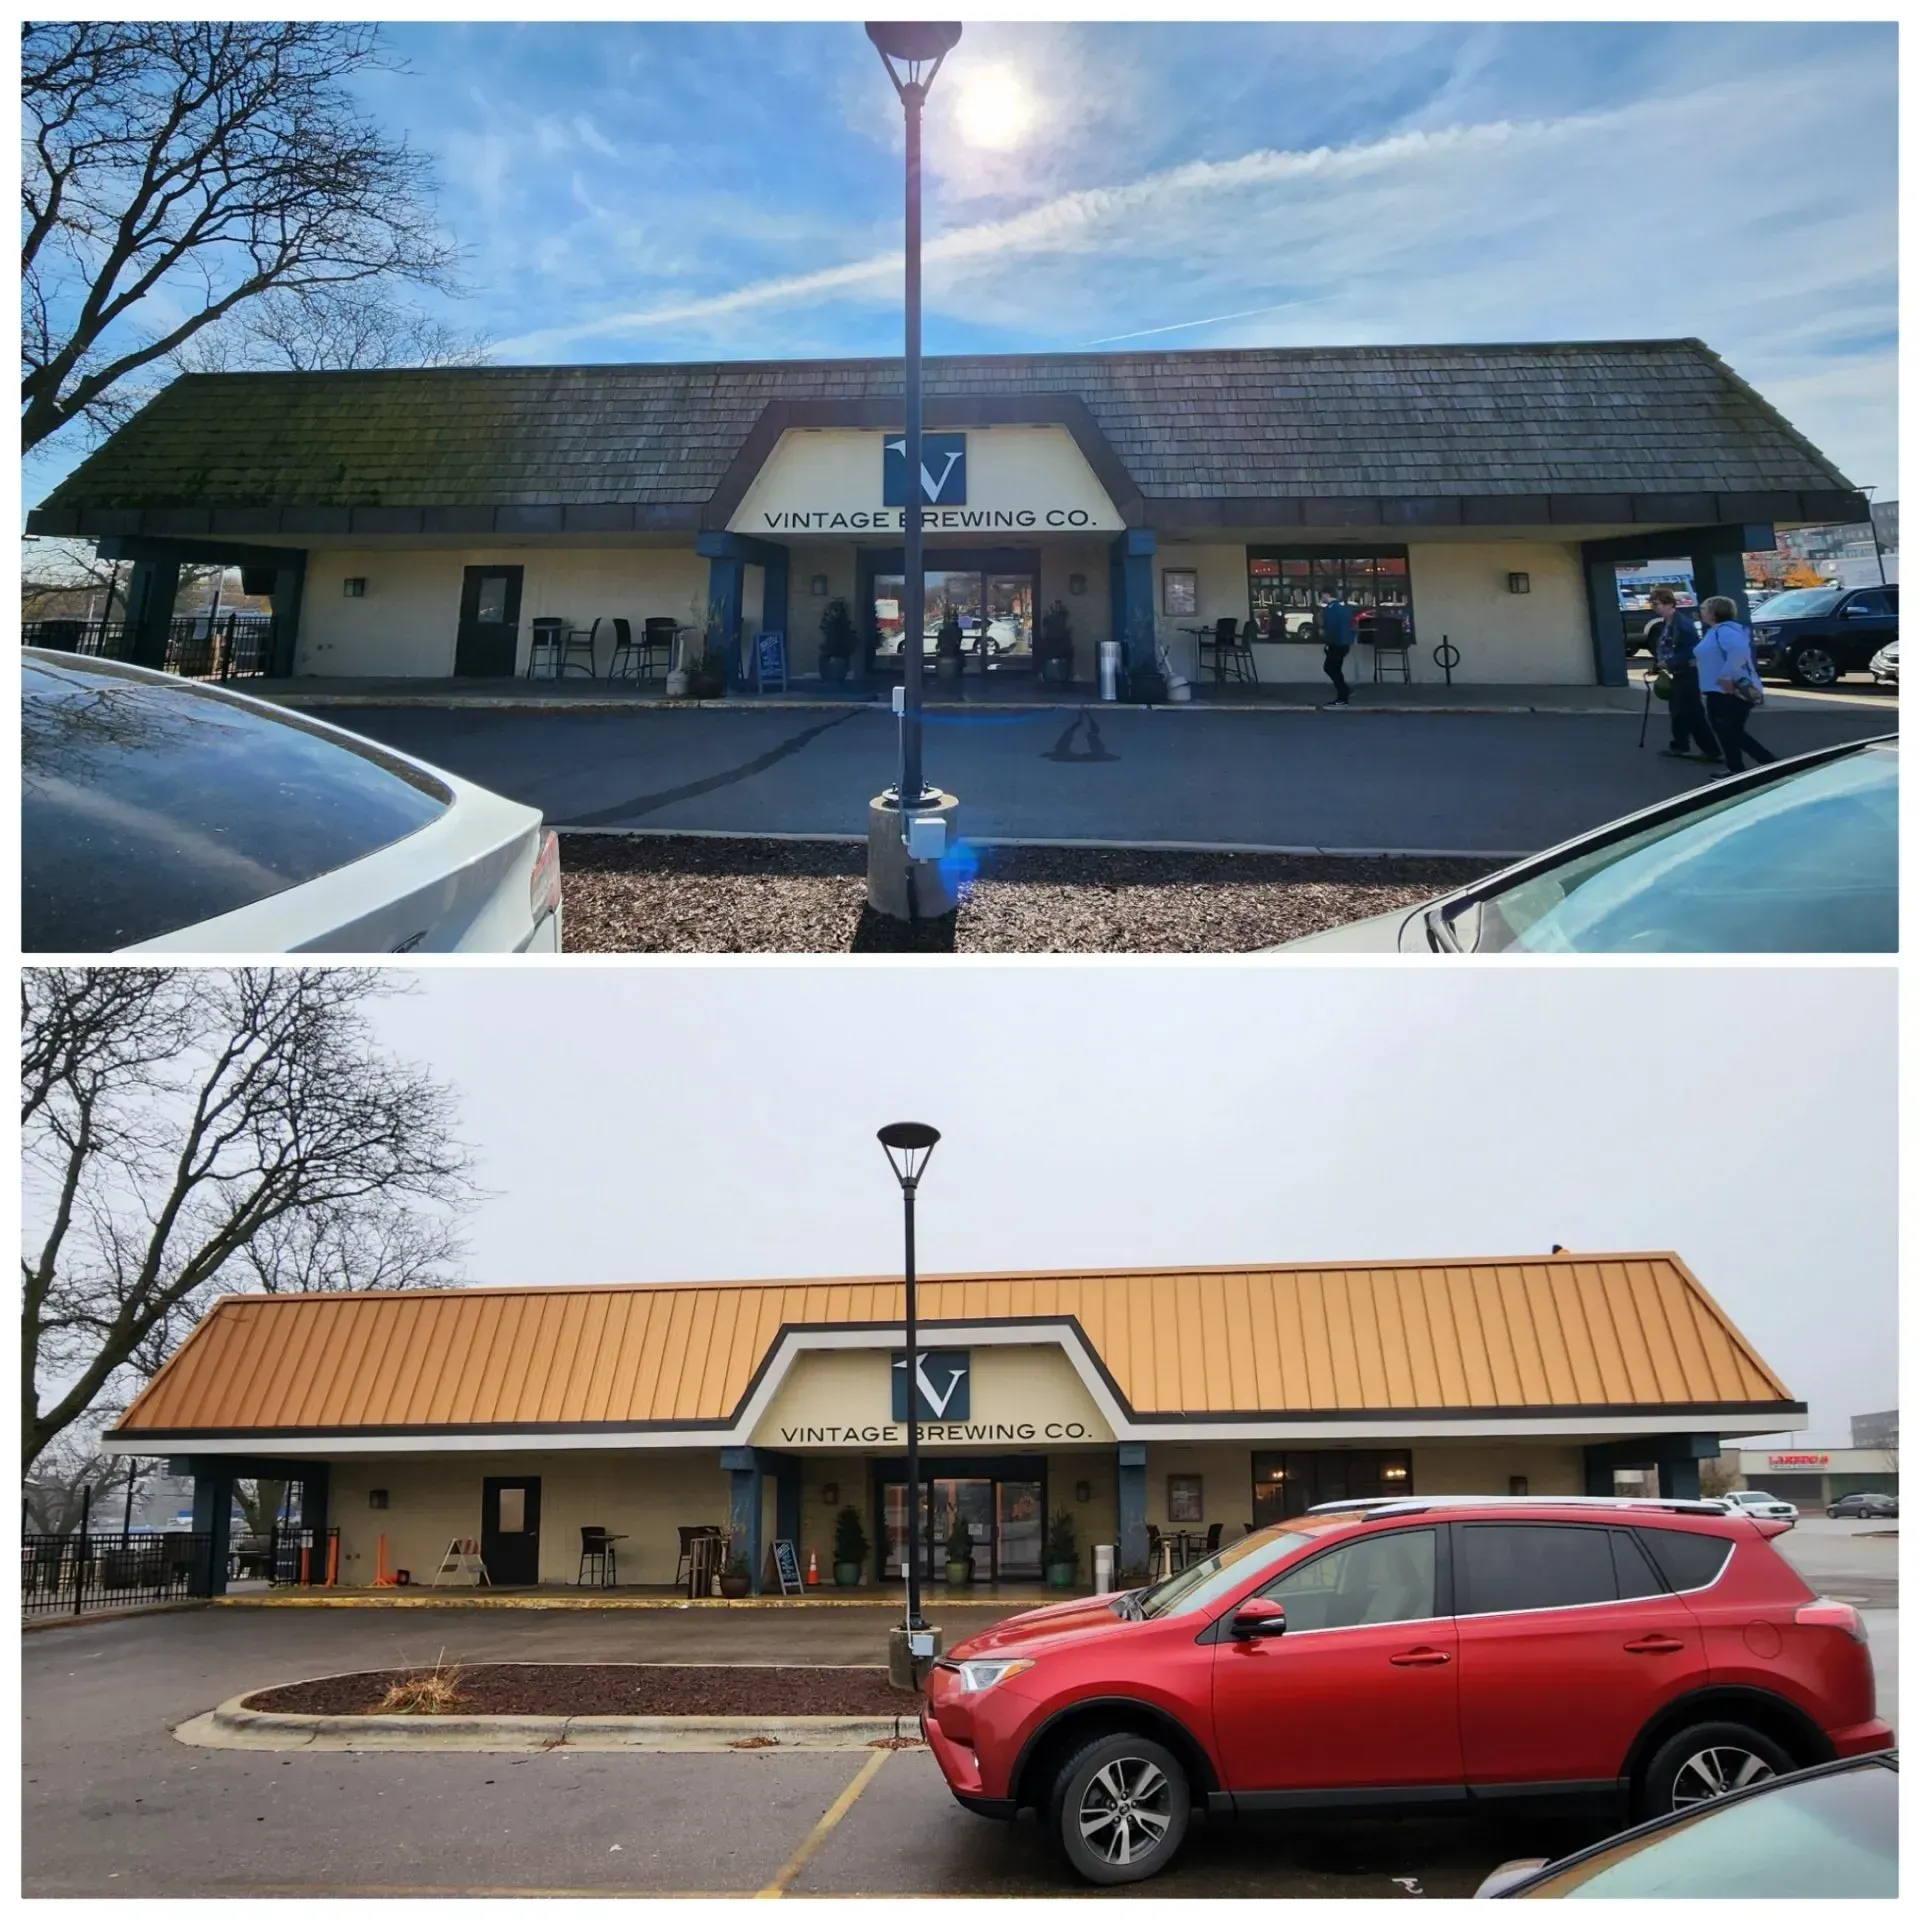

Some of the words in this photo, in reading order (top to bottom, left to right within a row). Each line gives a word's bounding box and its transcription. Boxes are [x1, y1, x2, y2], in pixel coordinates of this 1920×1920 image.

[885, 439, 963, 503] V
[764, 511, 890, 529] VINTAGE
[1045, 509, 1097, 527] CO.
[893, 1352, 966, 1418] V
[781, 1426, 898, 1442] VINTAGE
[914, 1423, 1036, 1441] BREWING
[1045, 1422, 1093, 1440] CO.
